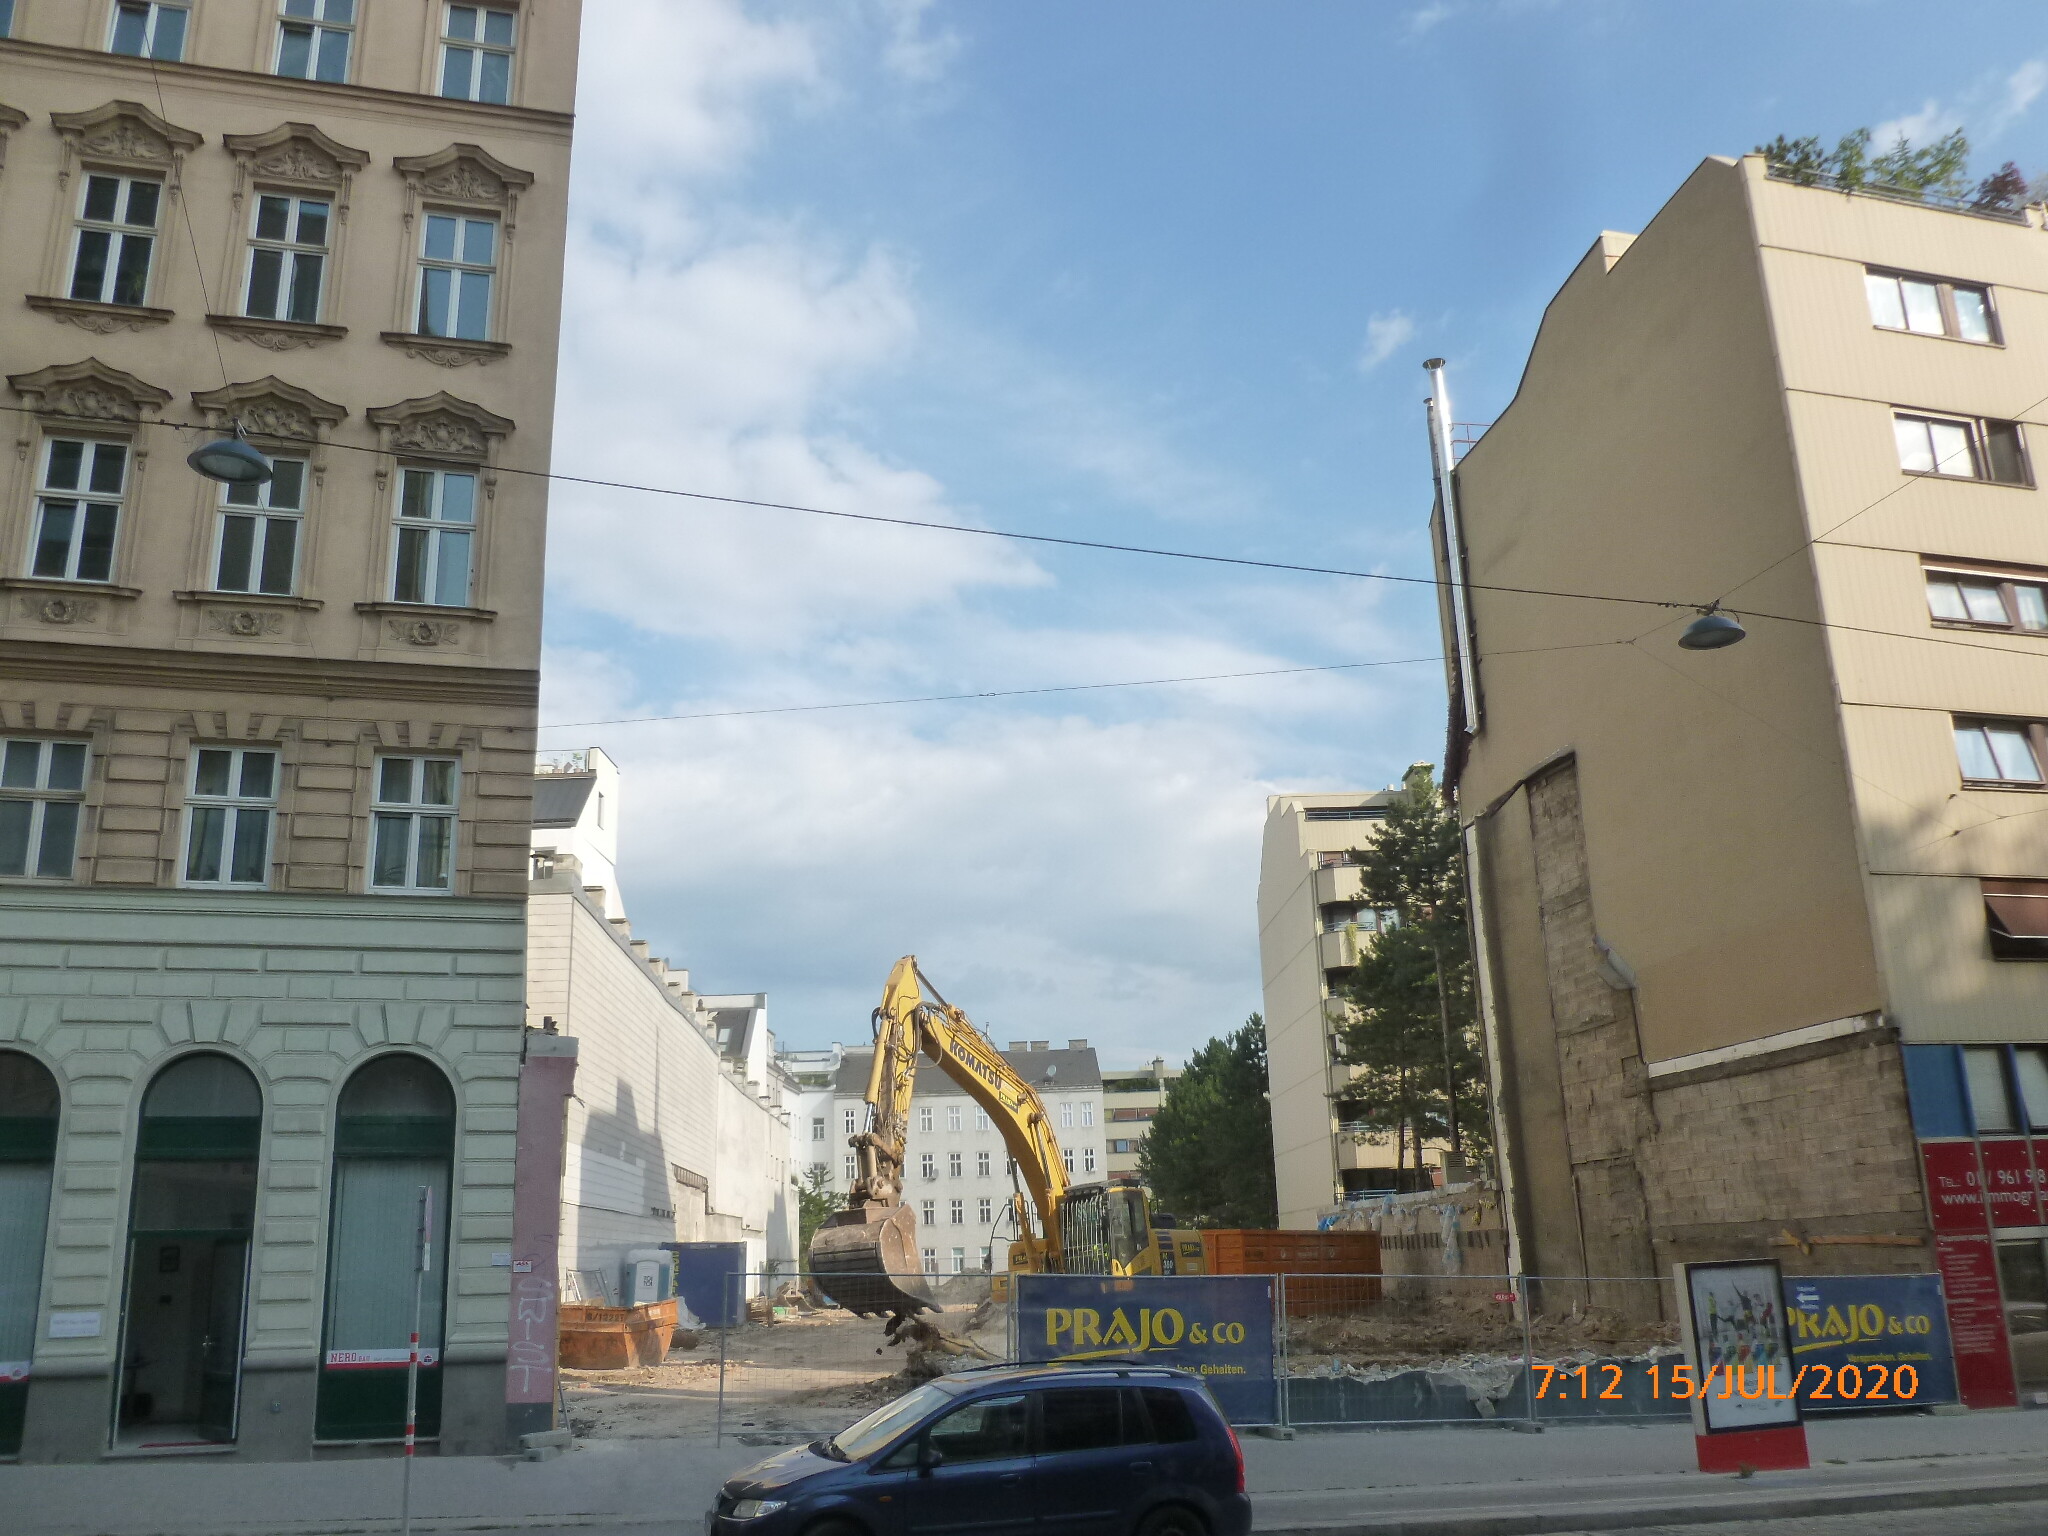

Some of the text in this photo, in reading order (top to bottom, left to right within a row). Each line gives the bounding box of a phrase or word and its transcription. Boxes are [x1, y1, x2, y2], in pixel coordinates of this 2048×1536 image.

[950, 1039, 1001, 1091] KOMATSU
[1046, 1307, 1245, 1351] PRAJO & CO
[1888, 1316, 1903, 1335] &
[1200, 1364, 1246, 1375] Gehalten.
